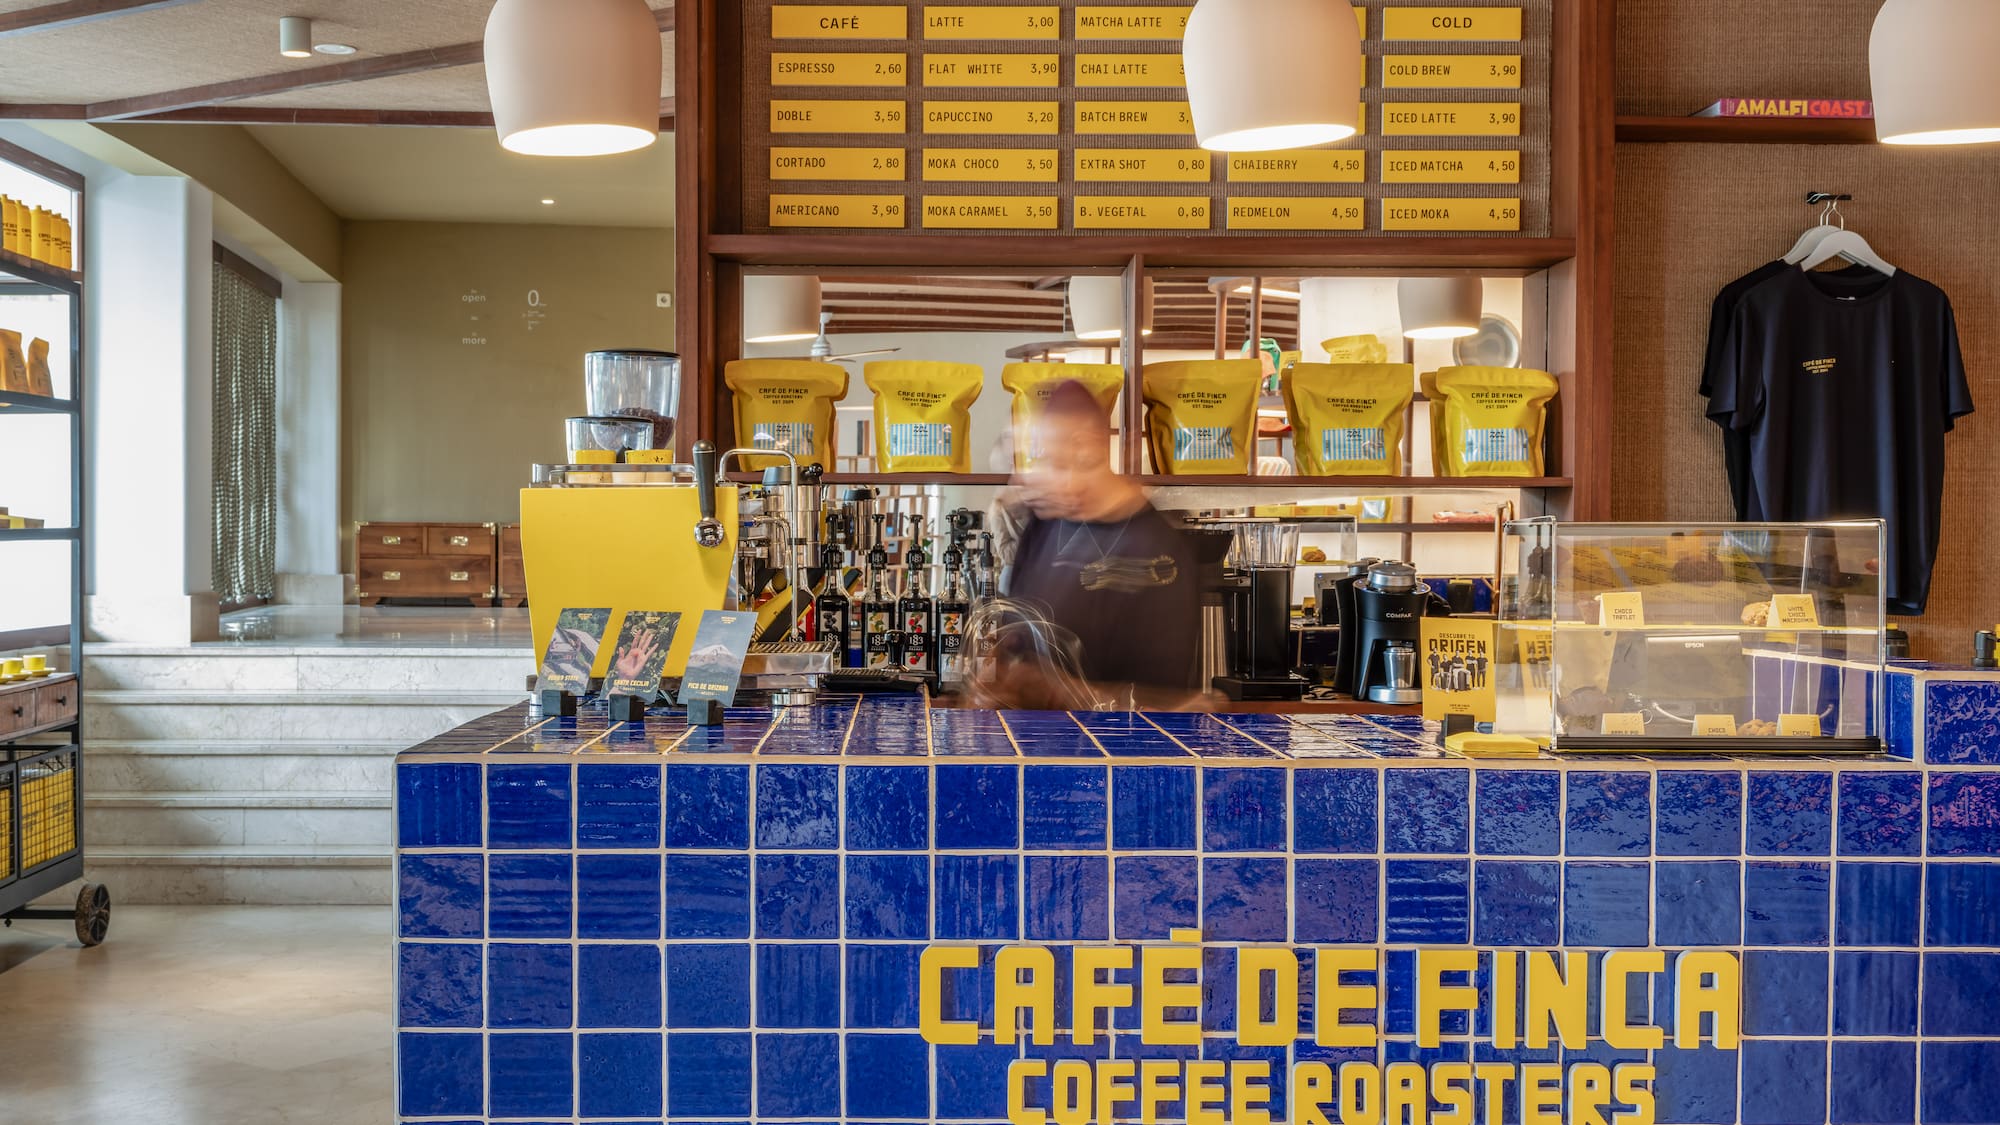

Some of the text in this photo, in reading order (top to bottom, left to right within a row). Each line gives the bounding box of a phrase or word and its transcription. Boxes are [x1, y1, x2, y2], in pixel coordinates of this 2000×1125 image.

[819, 15, 860, 30] CAFÉ
[929, 16, 1054, 29] LATTE 3,00
[1080, 16, 1162, 28] MATCHA LATTE
[1431, 16, 1473, 29] COLD
[778, 62, 902, 75] ESPRESSO 2,60
[928, 62, 1058, 76] FLAT WHITE 3,90
[1080, 63, 1148, 75] CHAI LATTE
[1389, 64, 1517, 77] COLD BREW 3,90
[1736, 99, 1808, 116] AMALFI
[1809, 101, 1865, 116] COAST
[777, 110, 901, 123] DOBLE 3,50
[928, 111, 1054, 124] CAPUCCINO 3,20
[1080, 111, 1116, 122] BATCH
[1119, 111, 1148, 123] BREW
[1389, 112, 1516, 125] ICED LATTE 3,90
[775, 156, 900, 170] CORTADO 2,80
[927, 158, 1053, 171] MOKA CHOCO 3,50
[1080, 158, 1205, 172] EXTRA SHOT 0,80
[1233, 159, 1360, 172] CHAIBERRY 4,50
[1389, 160, 1516, 173] ICED MATCHA 4,50
[775, 204, 900, 218] AMERICANO 3,90
[927, 205, 1053, 219] MOKA CARAMEL 3,50
[1097, 206, 1147, 217] VEGETAL
[1177, 206, 1205, 219] 0,80
[1233, 206, 1359, 220] REDMELON 4,50
[1390, 208, 1516, 221] ICED MOKA 4,50
[462, 294, 486, 303] open
[462, 337, 487, 345] more
[1429, 638, 1487, 654] ORIGEN
[920, 928, 1739, 1050] CAFÉ DE FINCA
[1007, 1059, 1655, 1125] COFFEE ROASTERS
